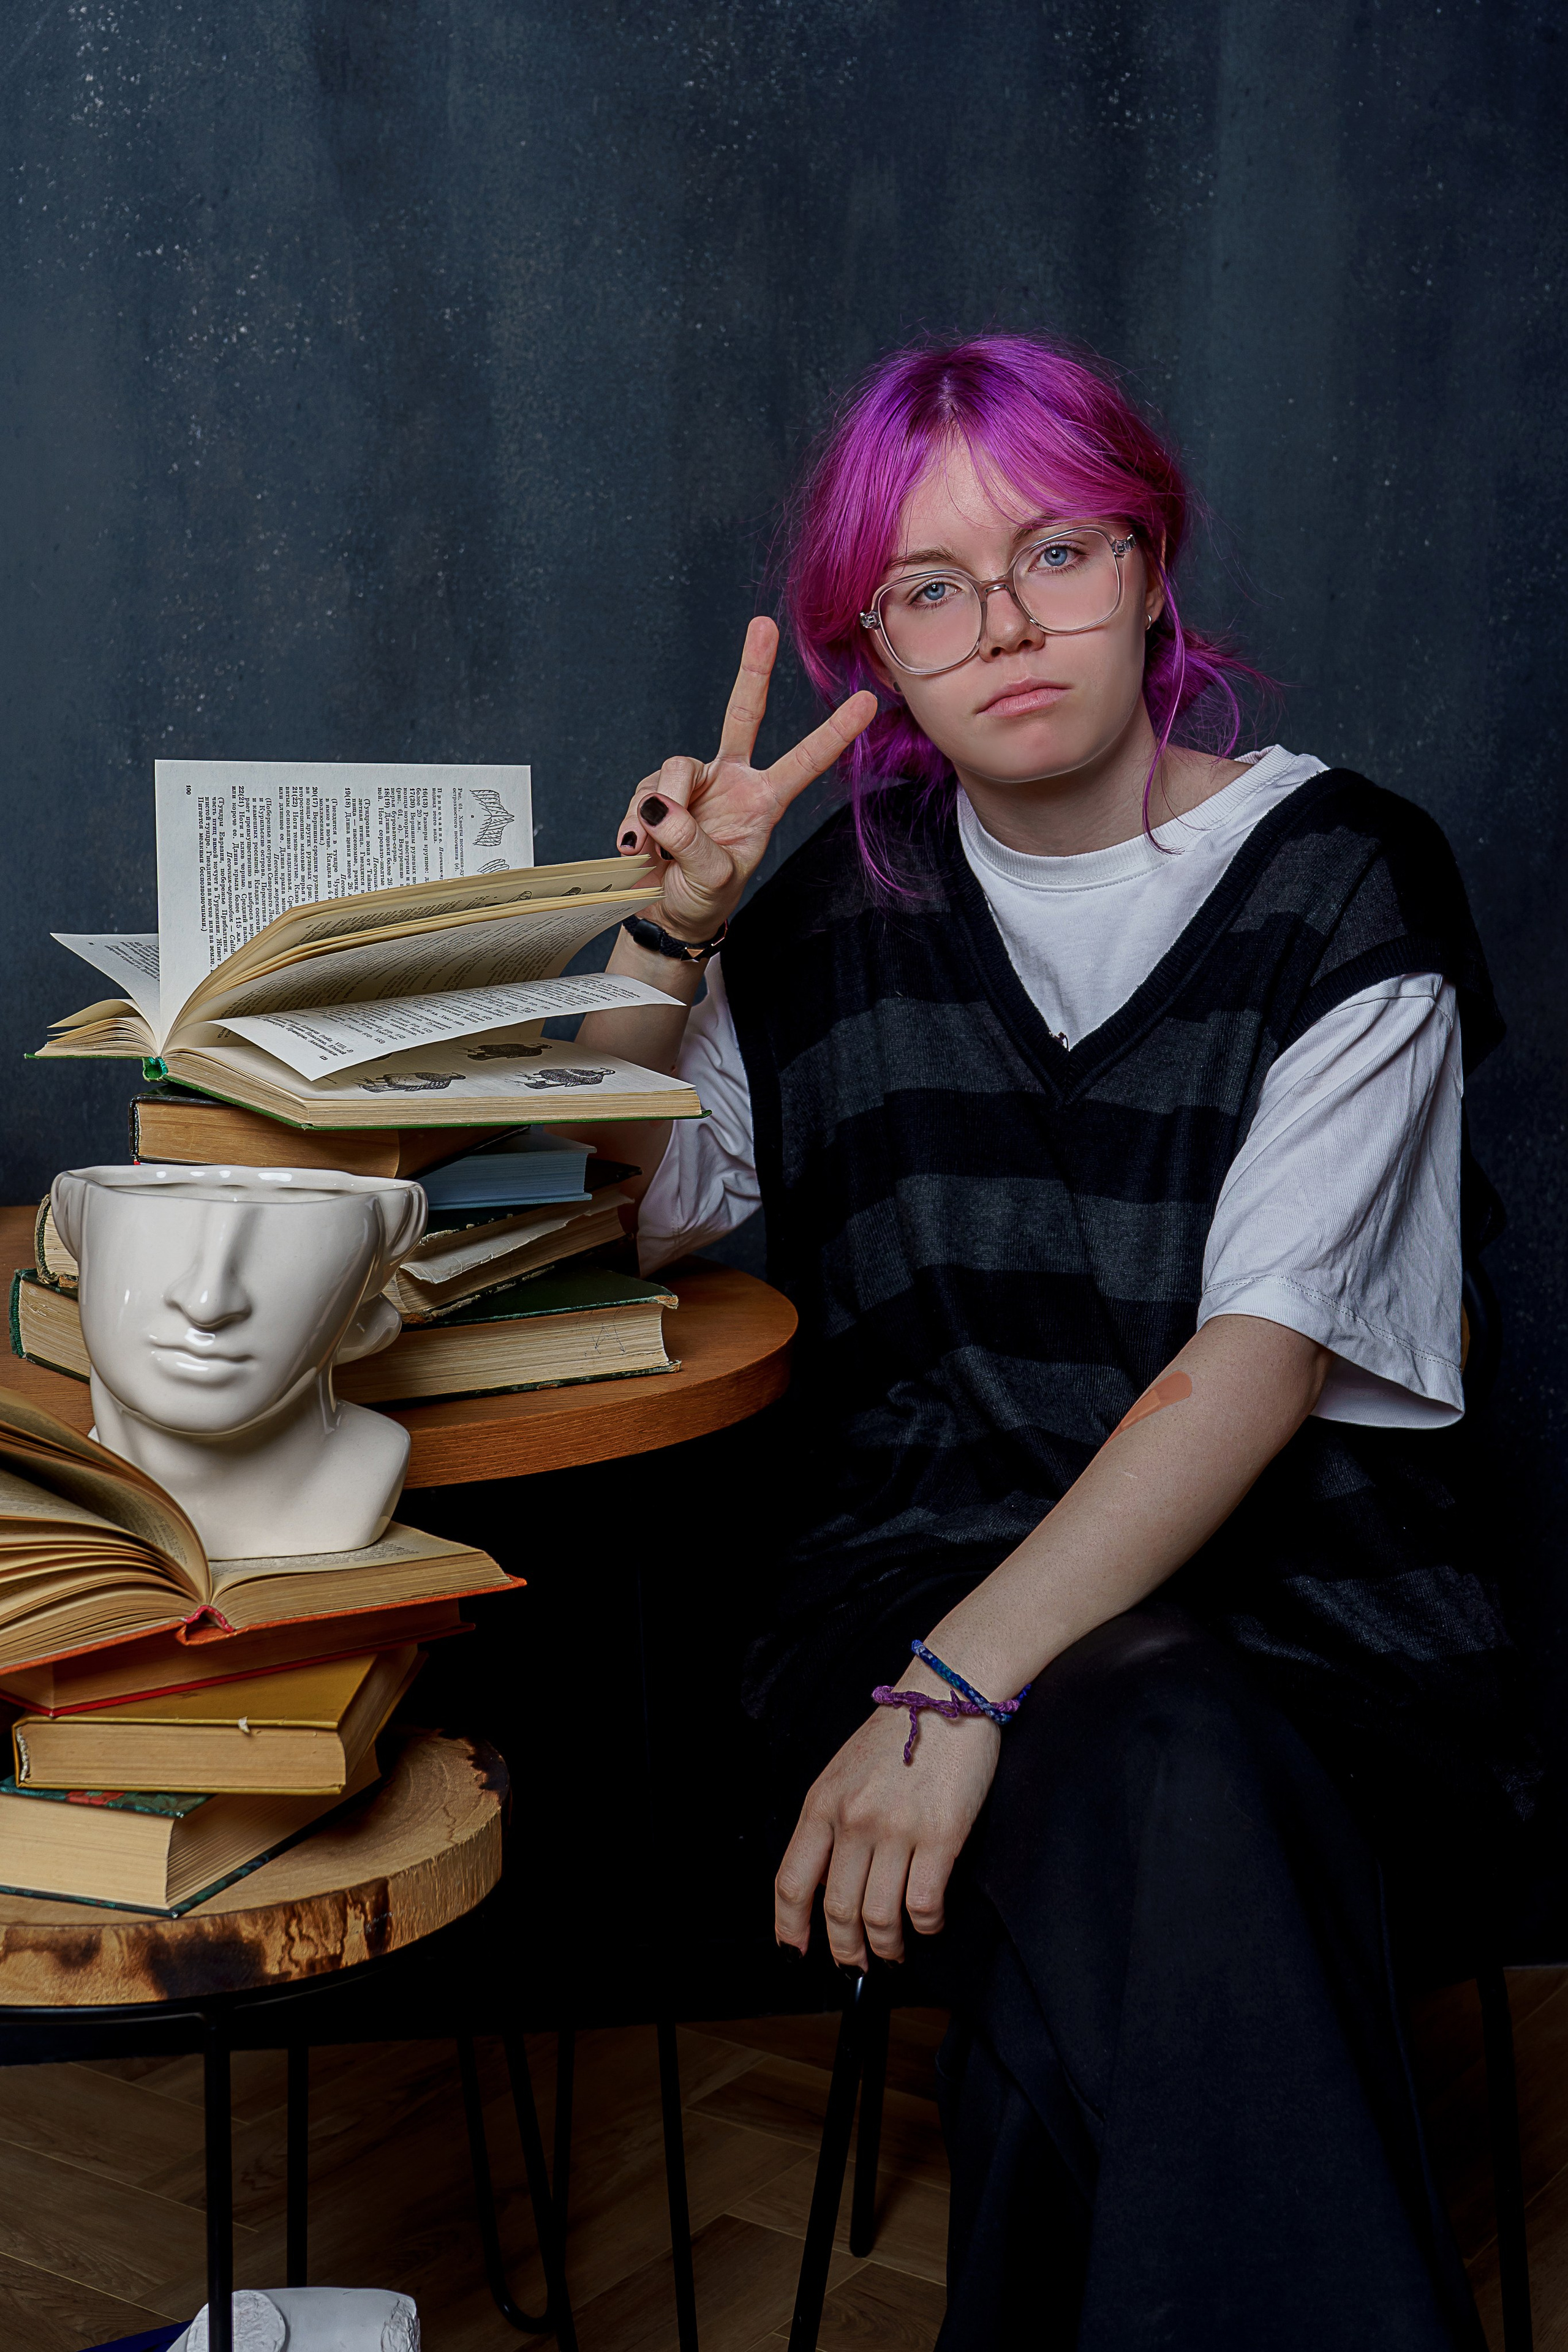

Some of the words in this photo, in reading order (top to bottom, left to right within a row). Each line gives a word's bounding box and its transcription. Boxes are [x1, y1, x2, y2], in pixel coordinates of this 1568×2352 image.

[417, 809, 422, 818] 20
[248, 880, 252, 889] из
[208, 888, 212, 897] на
[209, 935, 214, 944] на
